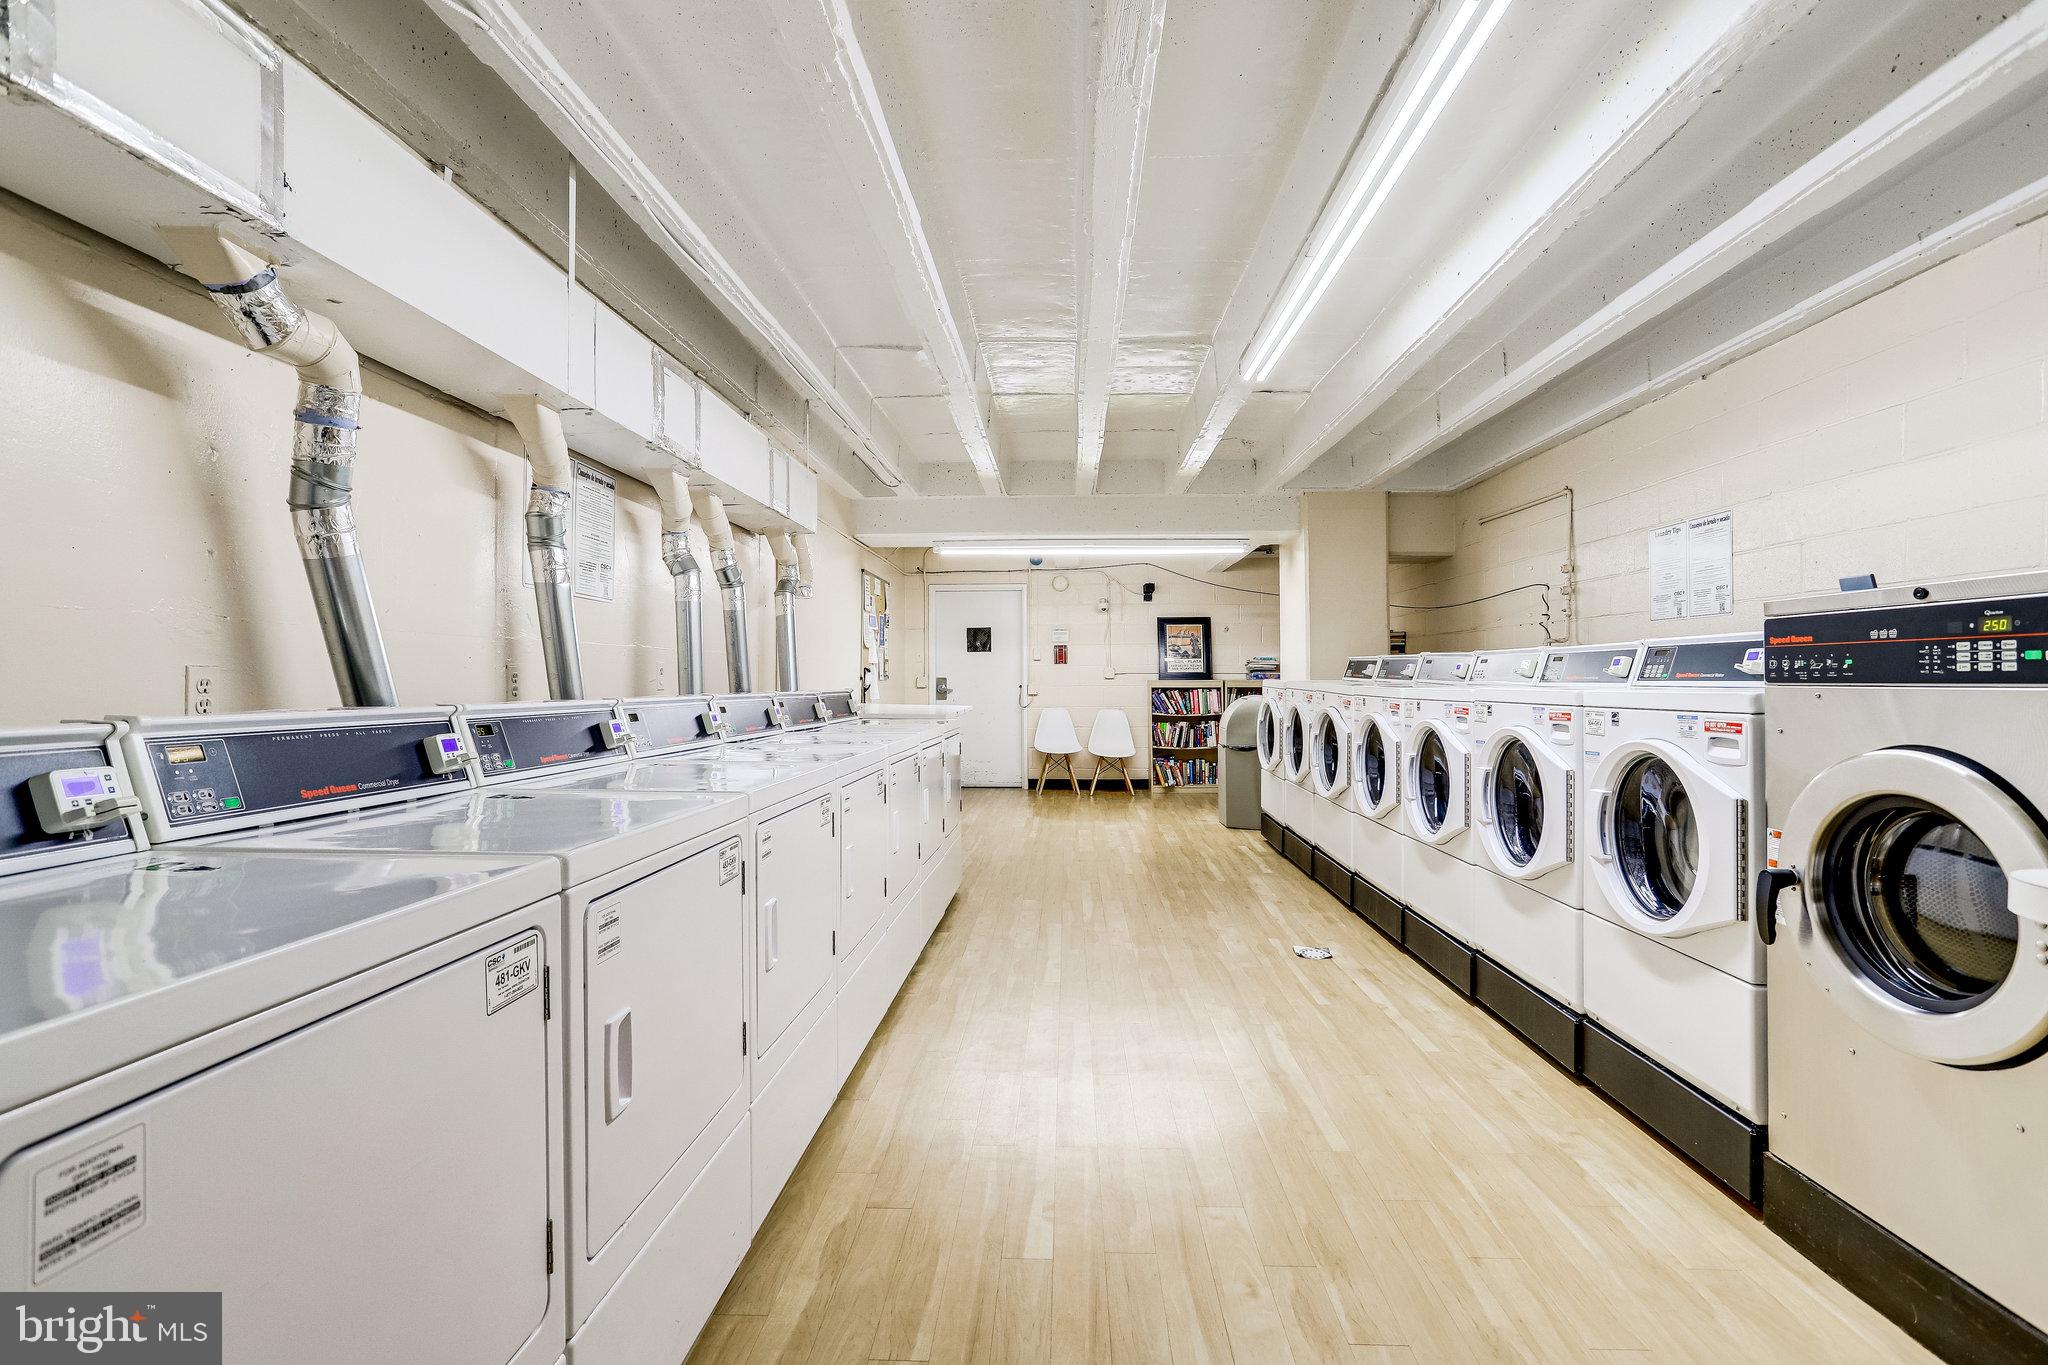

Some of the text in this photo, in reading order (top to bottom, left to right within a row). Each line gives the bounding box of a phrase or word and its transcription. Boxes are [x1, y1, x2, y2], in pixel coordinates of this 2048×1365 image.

[1983, 619, 2008, 631] 250
[1769, 635, 1813, 645] Speed Queen
[271, 733, 312, 742] PERMANENT
[300, 778, 400, 799] Speed Queen Commercial Dryer
[488, 955, 502, 968] CSC
[495, 958, 531, 986] 481-GKV
